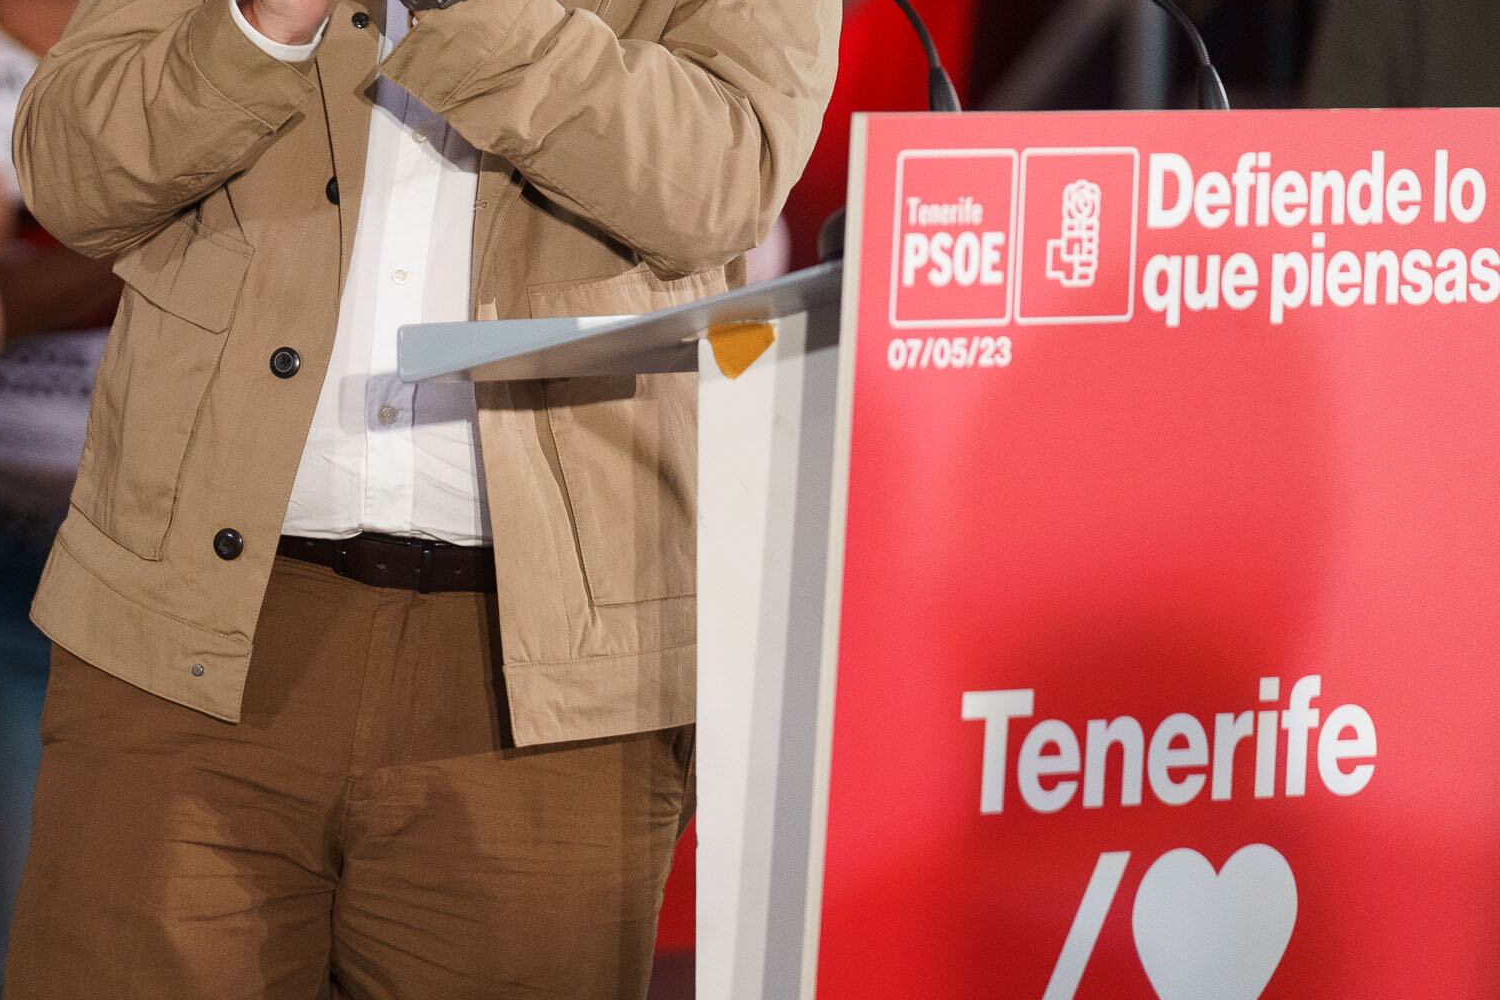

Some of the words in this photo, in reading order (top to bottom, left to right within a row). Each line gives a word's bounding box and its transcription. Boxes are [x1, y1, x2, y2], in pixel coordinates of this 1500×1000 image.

[906, 196, 984, 226] Tenerife
[1147, 149, 1422, 229] Defiende
[1434, 149, 1487, 224] lo
[902, 231, 1006, 287] PSOE
[1142, 253, 1260, 327] que
[1269, 231, 1500, 325] piensas
[887, 335, 1012, 370] 07/05/23
[961, 674, 1378, 815] Tenerife
